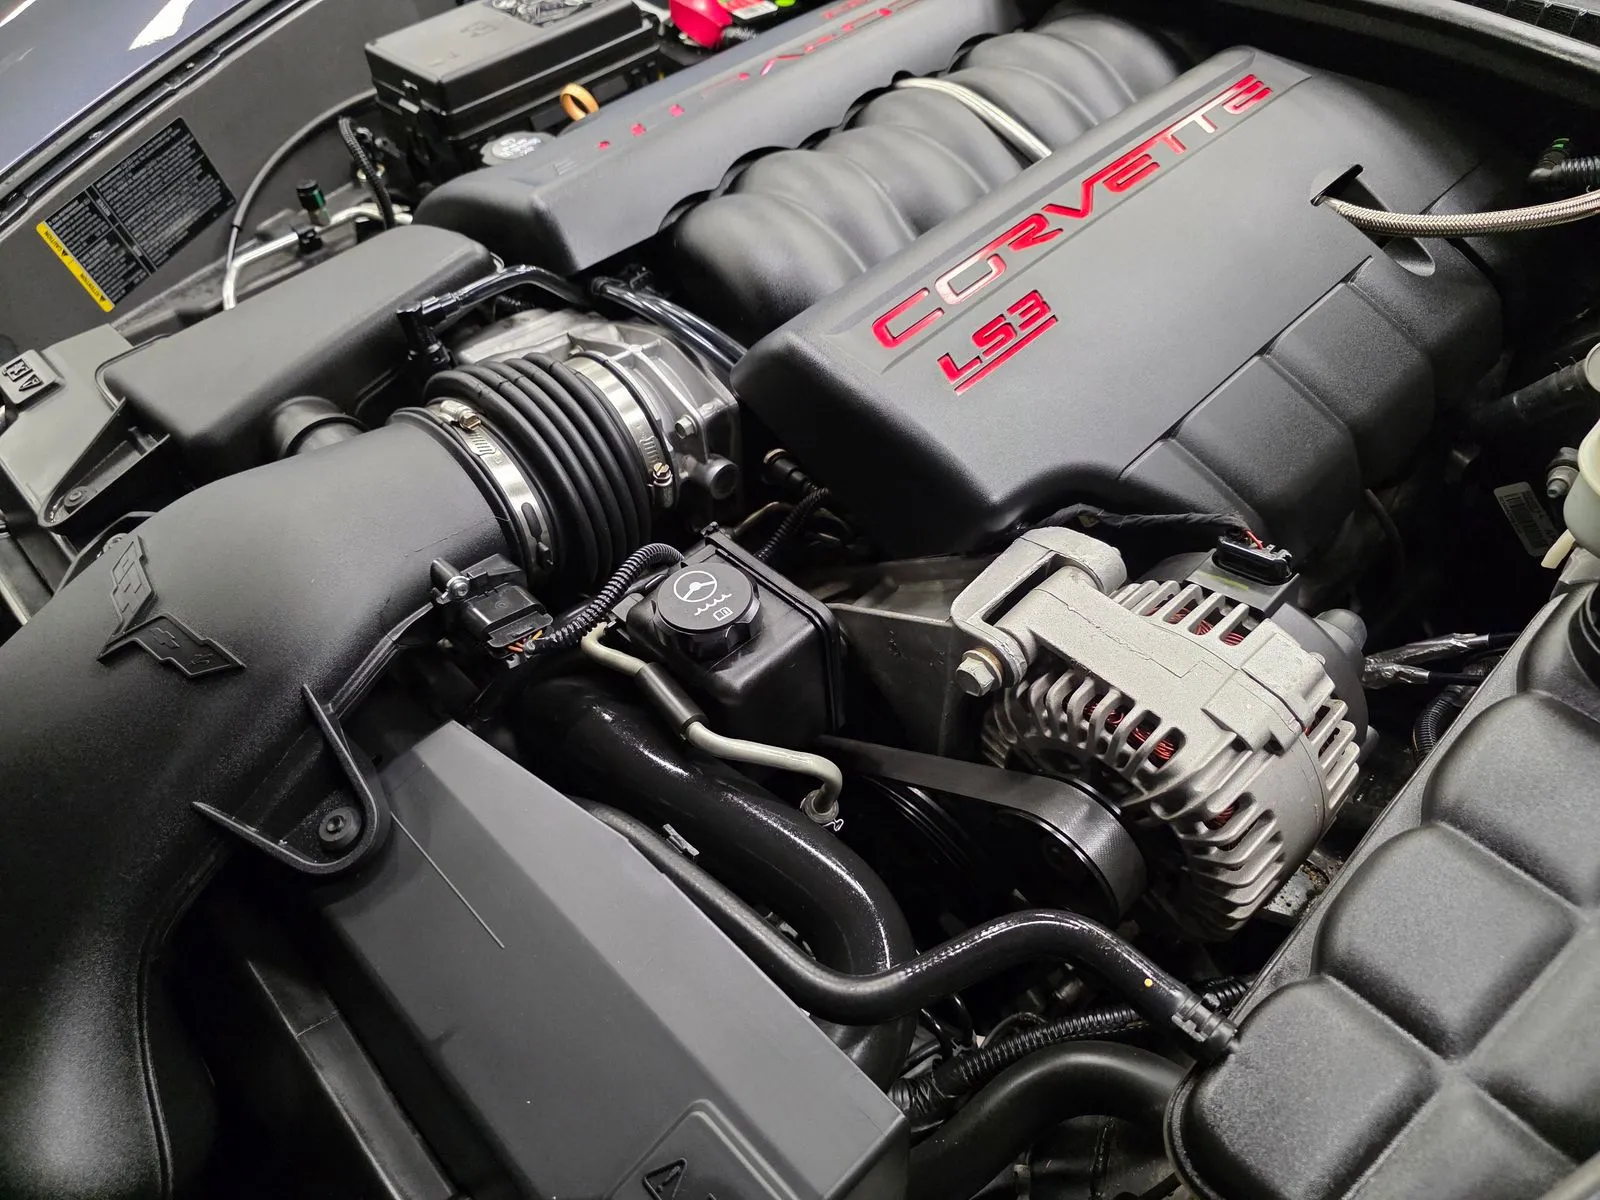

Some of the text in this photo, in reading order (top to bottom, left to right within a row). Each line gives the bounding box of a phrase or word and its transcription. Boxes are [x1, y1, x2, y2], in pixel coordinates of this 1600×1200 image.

[43, 230, 63, 252] CAUTION
[871, 73, 1273, 349] CORVETTE
[936, 289, 1053, 385] LS3
